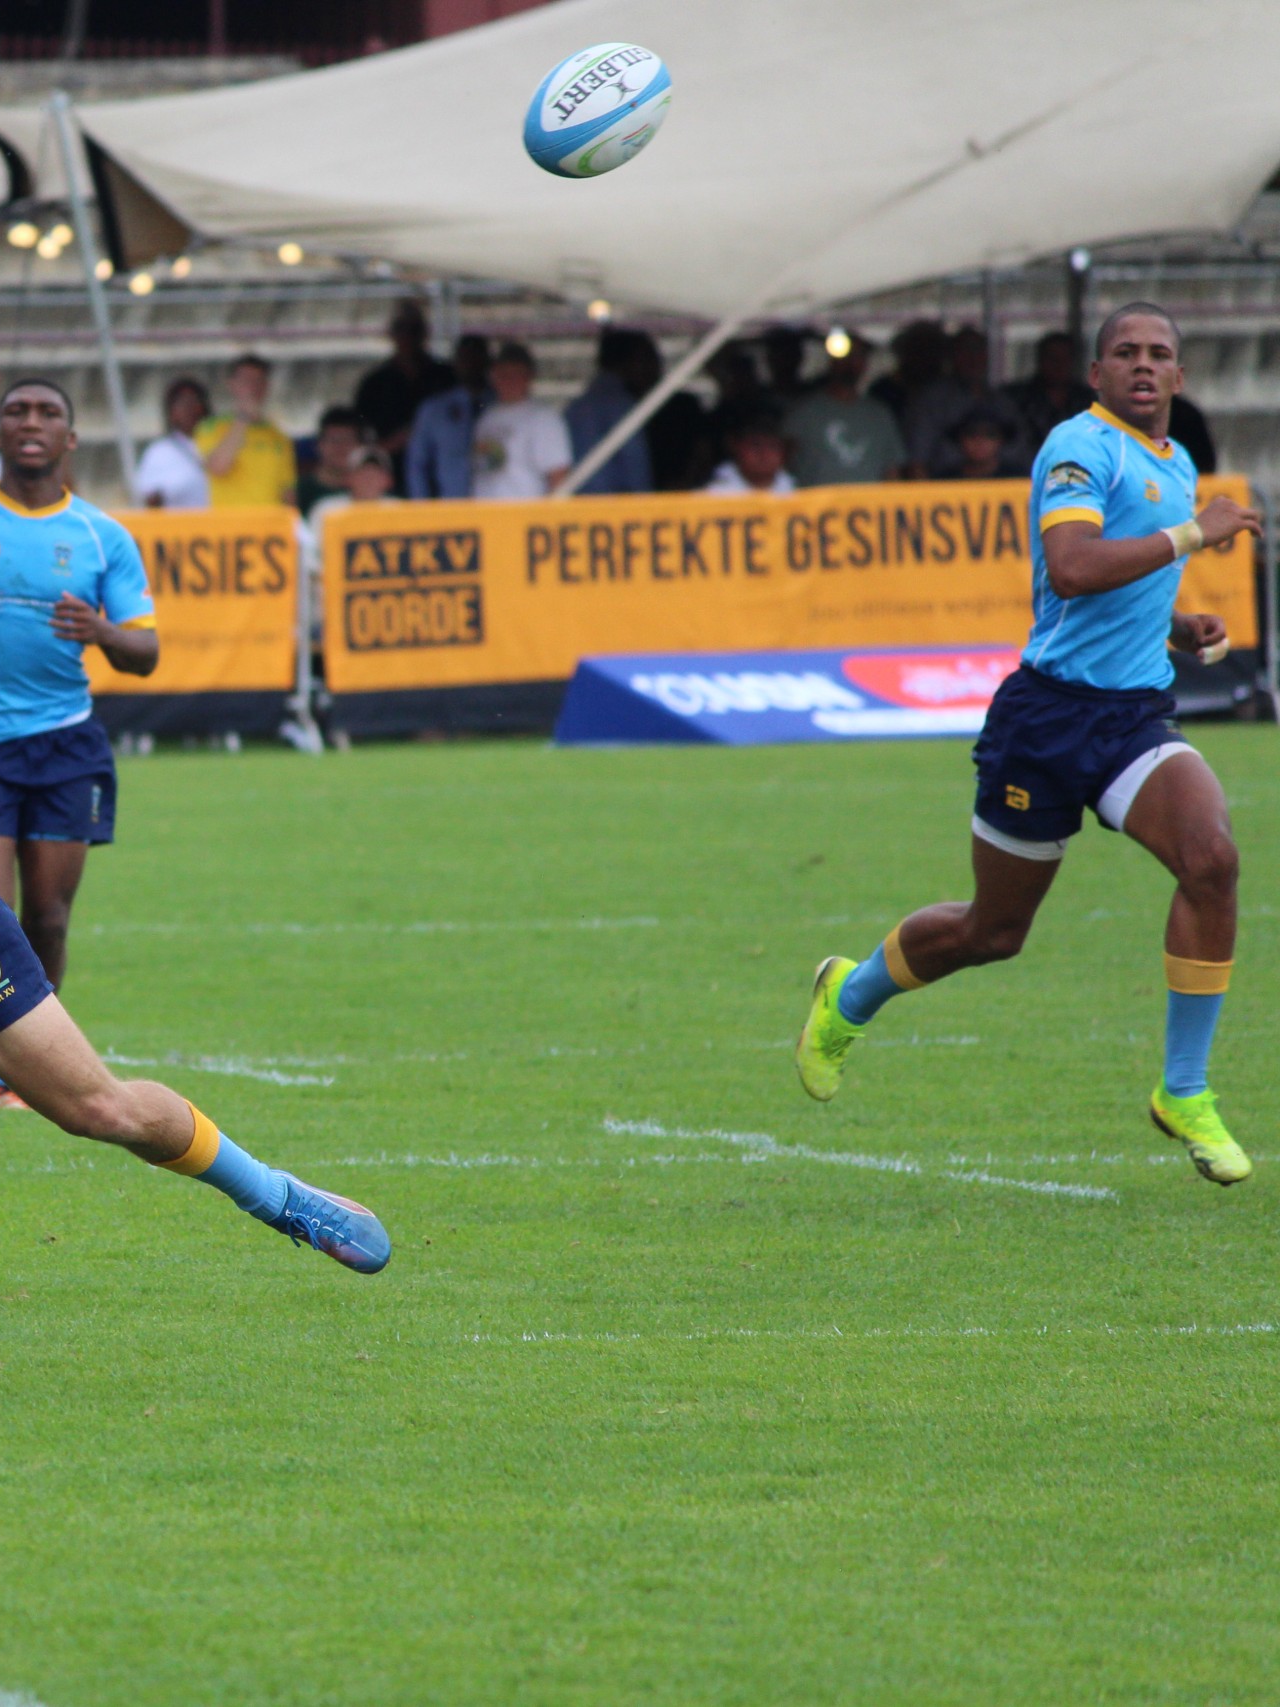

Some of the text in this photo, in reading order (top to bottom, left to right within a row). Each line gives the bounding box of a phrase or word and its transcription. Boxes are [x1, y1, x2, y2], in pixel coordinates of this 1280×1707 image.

[551, 47, 653, 121] GILBERT
[349, 536, 475, 576] ATKV
[526, 502, 1026, 586] PERFEKTE GESINSVA
[3, 985, 15, 997] XV
